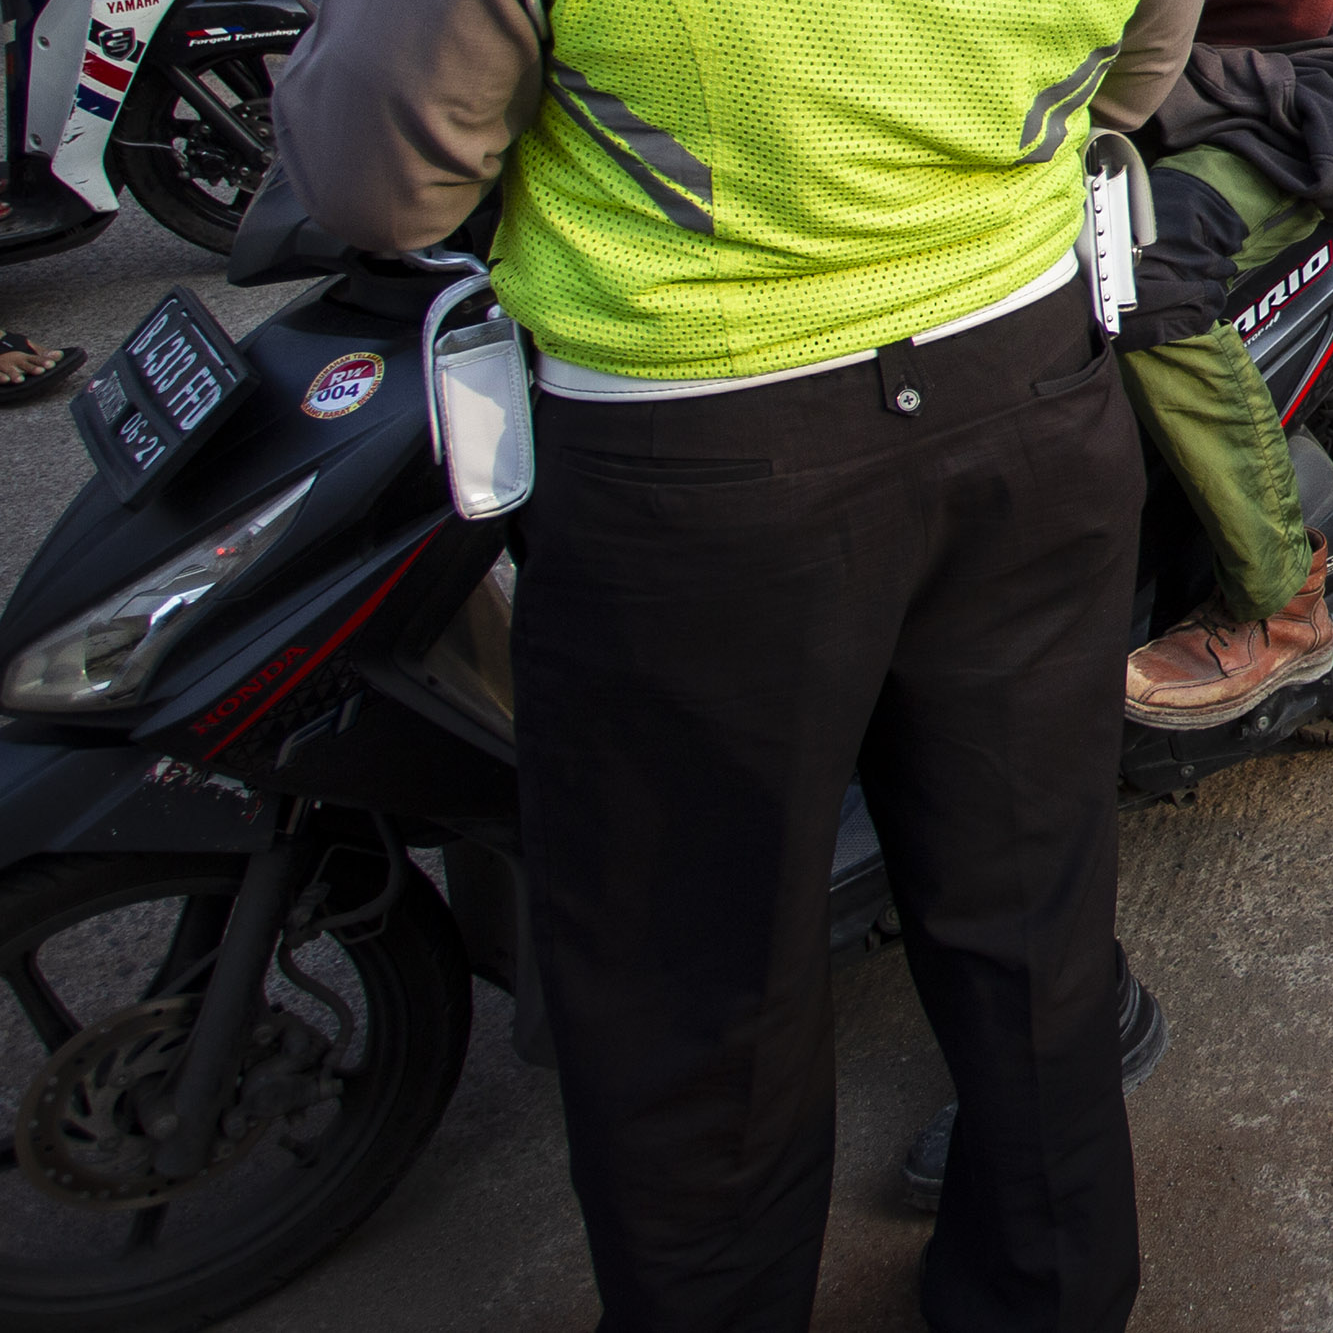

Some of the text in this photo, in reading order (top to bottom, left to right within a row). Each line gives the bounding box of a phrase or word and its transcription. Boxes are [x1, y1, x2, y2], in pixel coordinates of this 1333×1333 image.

[188, 27, 301, 48] Forged Technology
[1232, 243, 1331, 333] ARIO
[132, 314, 169, 356] B
[328, 365, 370, 387] RW
[316, 382, 360, 403] 004
[188, 645, 311, 735] HONDA
